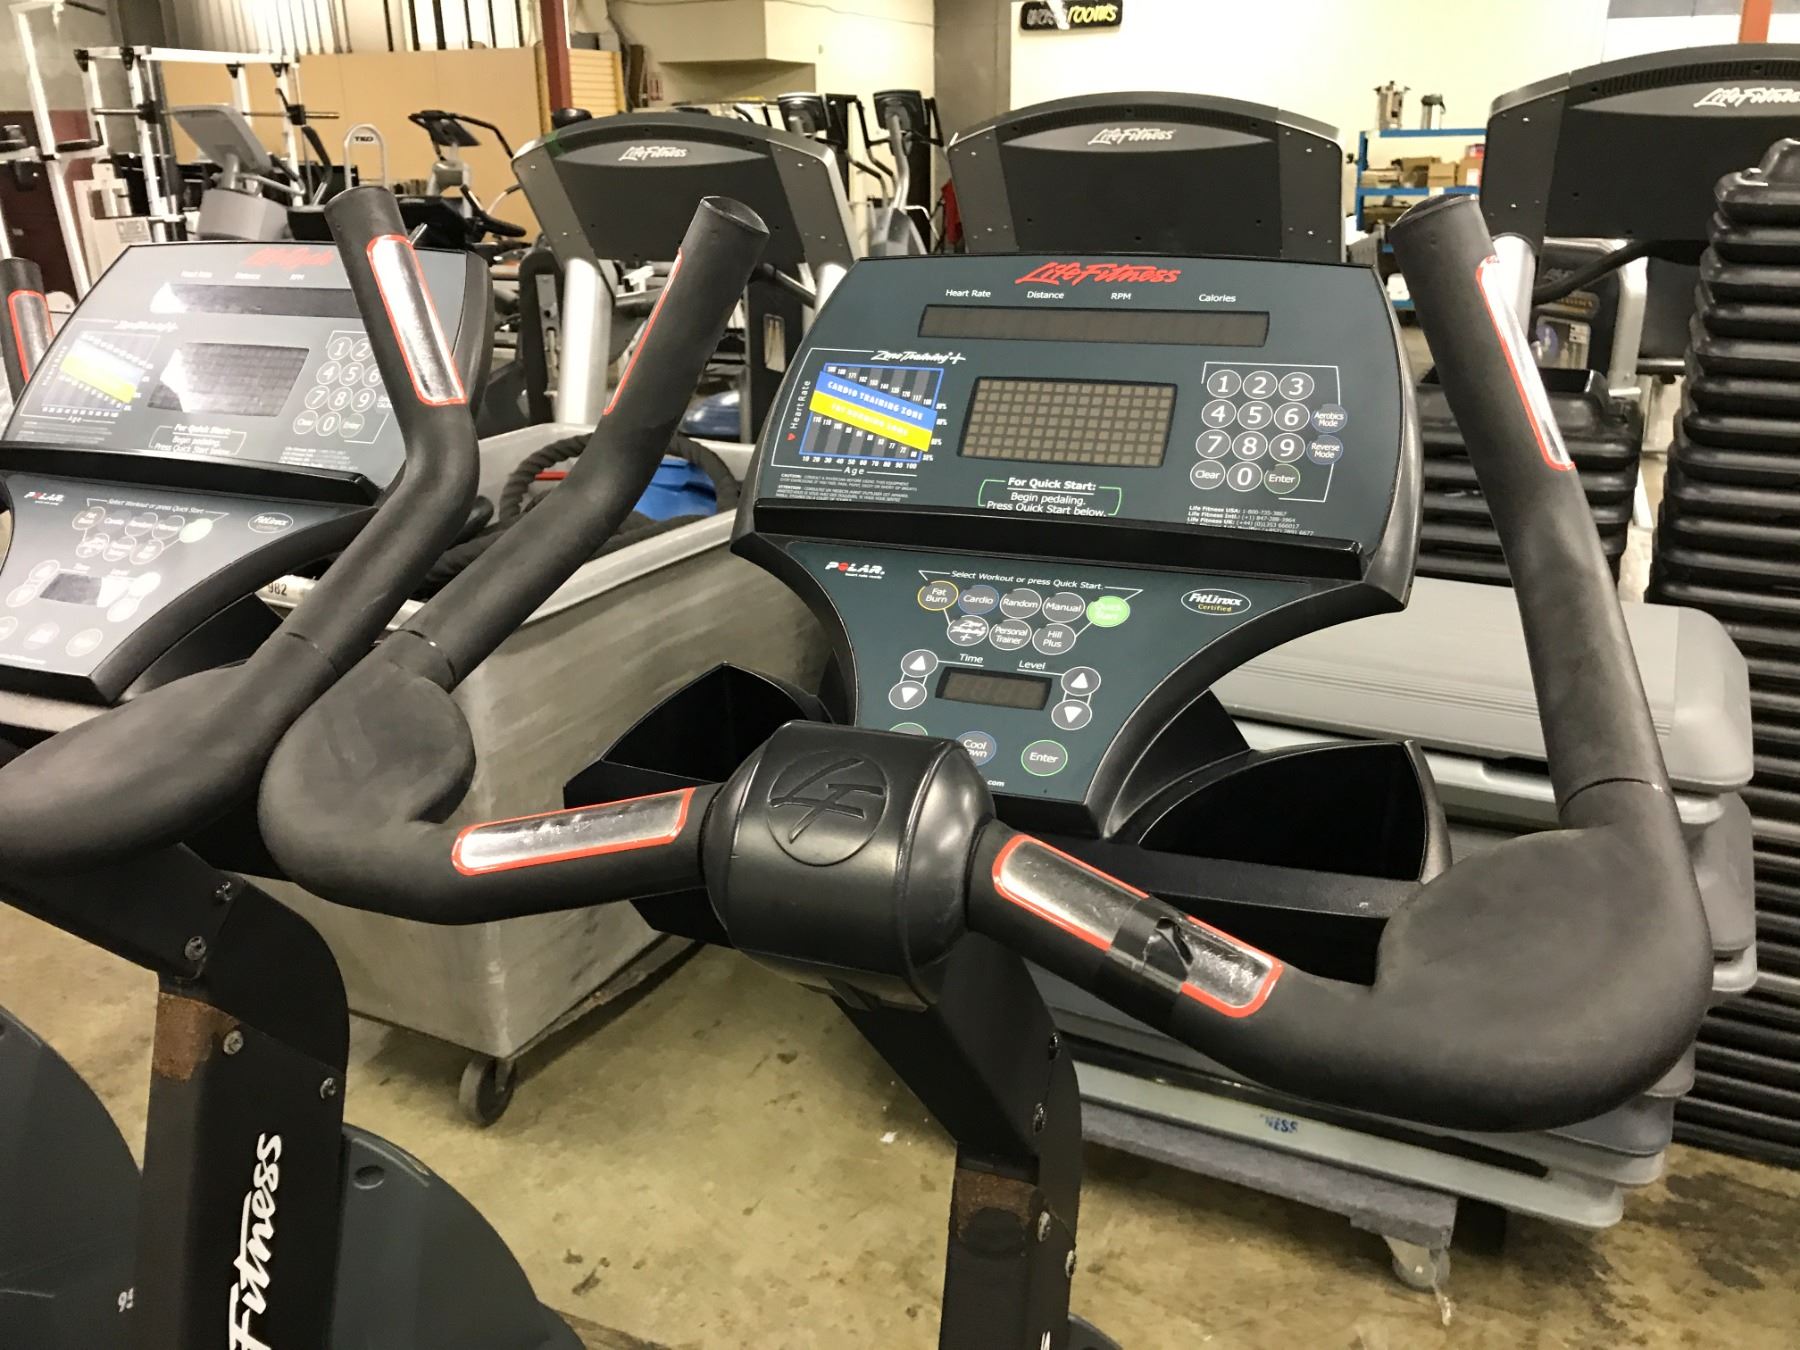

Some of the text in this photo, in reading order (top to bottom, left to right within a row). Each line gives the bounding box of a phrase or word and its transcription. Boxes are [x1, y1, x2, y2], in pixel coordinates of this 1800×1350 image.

[945, 288, 991, 298] Heart Rate
[1027, 291, 1065, 300] Distance
[1110, 292, 1132, 300] RPM
[1199, 294, 1236, 303] Calories
[334, 342, 345, 356] 1
[356, 343, 370, 357] 2
[323, 366, 336, 380] 4
[345, 367, 359, 381] 5
[369, 368, 380, 382] 6
[1217, 375, 1229, 393] 1
[1252, 376, 1267, 394] 2
[1289, 377, 1304, 396] 3
[312, 390, 326, 404] 7
[334, 391, 346, 406] 8
[358, 393, 370, 407] 9
[901, 407, 924, 421] ZONE
[1210, 405, 1226, 423] 4
[1247, 406, 1263, 424] 5
[1284, 407, 1299, 426] 6
[1314, 411, 1345, 420] Aerobics
[323, 417, 335, 432] 0
[1318, 419, 1338, 427] Mode
[1207, 435, 1222, 453] 7
[1242, 437, 1258, 455] 8
[1280, 438, 1295, 457] 9
[1311, 442, 1340, 451] Reverse
[1314, 450, 1335, 459] Mode
[844, 466, 865, 475] Age
[1195, 470, 1221, 479] Clear
[1237, 467, 1252, 486] 0
[1269, 474, 1296, 483] Enter
[1007, 477, 1096, 492] For Quick Start:
[1011, 491, 1086, 507] Begin pedaling.
[987, 501, 1107, 518] Press Quick Start below.
[951, 570, 977, 580] Select
[979, 572, 1014, 582] Workout
[1028, 577, 1050, 587] press
[1052, 578, 1079, 589] Quick
[1080, 580, 1104, 590] Start.
[931, 588, 947, 597] Fat
[925, 595, 948, 604] Burn
[963, 595, 994, 605] Cardio
[1002, 598, 1038, 609] Random
[1045, 602, 1081, 613] Manual
[1197, 603, 1233, 613] Certified
[995, 626, 1028, 637] Personal
[1047, 630, 1063, 639] Hill
[996, 635, 1023, 645] Trainer
[1042, 638, 1063, 648] Plus
[959, 653, 984, 664] Time
[1018, 660, 1047, 670] Level
[963, 739, 987, 750] Cool
[1029, 752, 1059, 763] Enter
